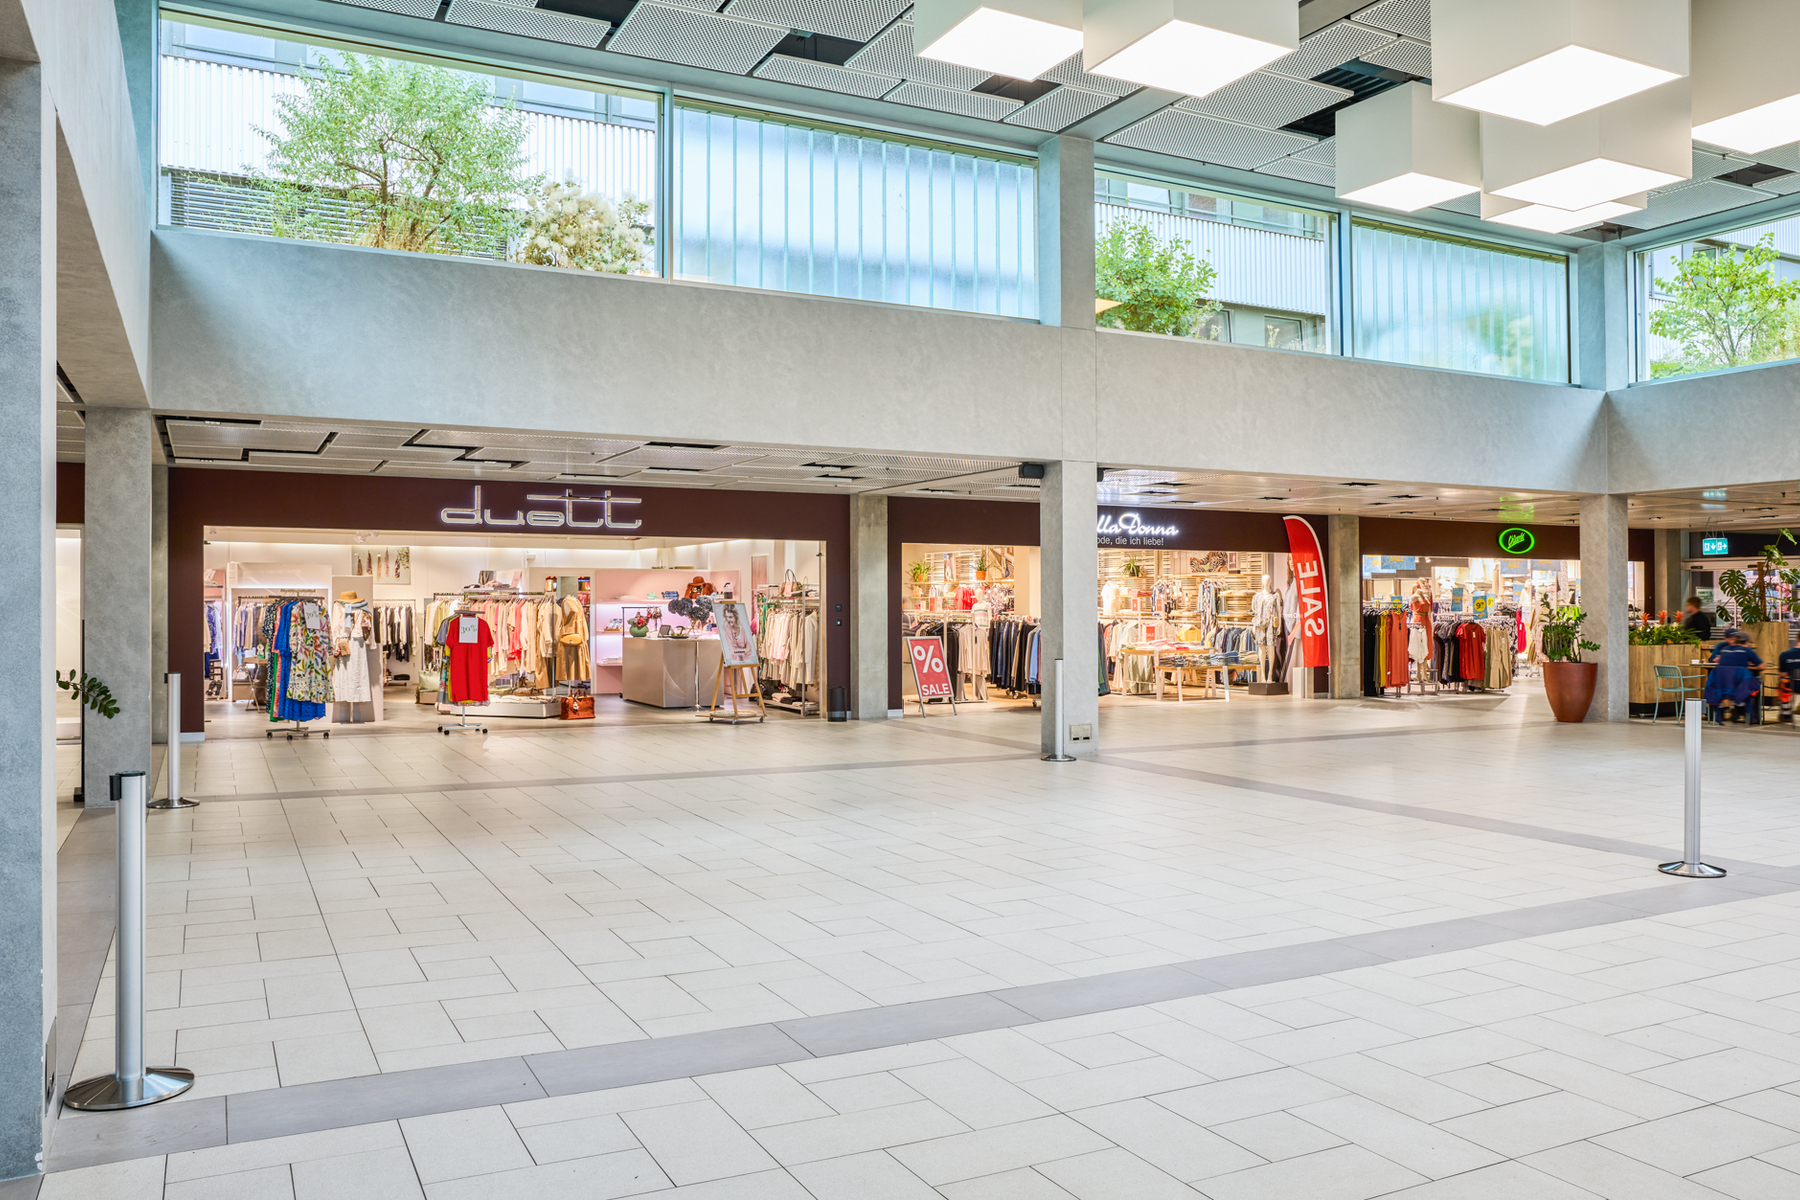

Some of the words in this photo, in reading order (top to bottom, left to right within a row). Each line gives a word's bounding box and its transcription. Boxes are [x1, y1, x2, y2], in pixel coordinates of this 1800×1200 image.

[1097, 536, 1113, 545] ode,
[1115, 536, 1127, 545] die
[1130, 536, 1141, 545] ich
[1143, 537, 1164, 546] liebe!
[460, 624, 477, 634] 30%
[921, 683, 950, 696] SALE
